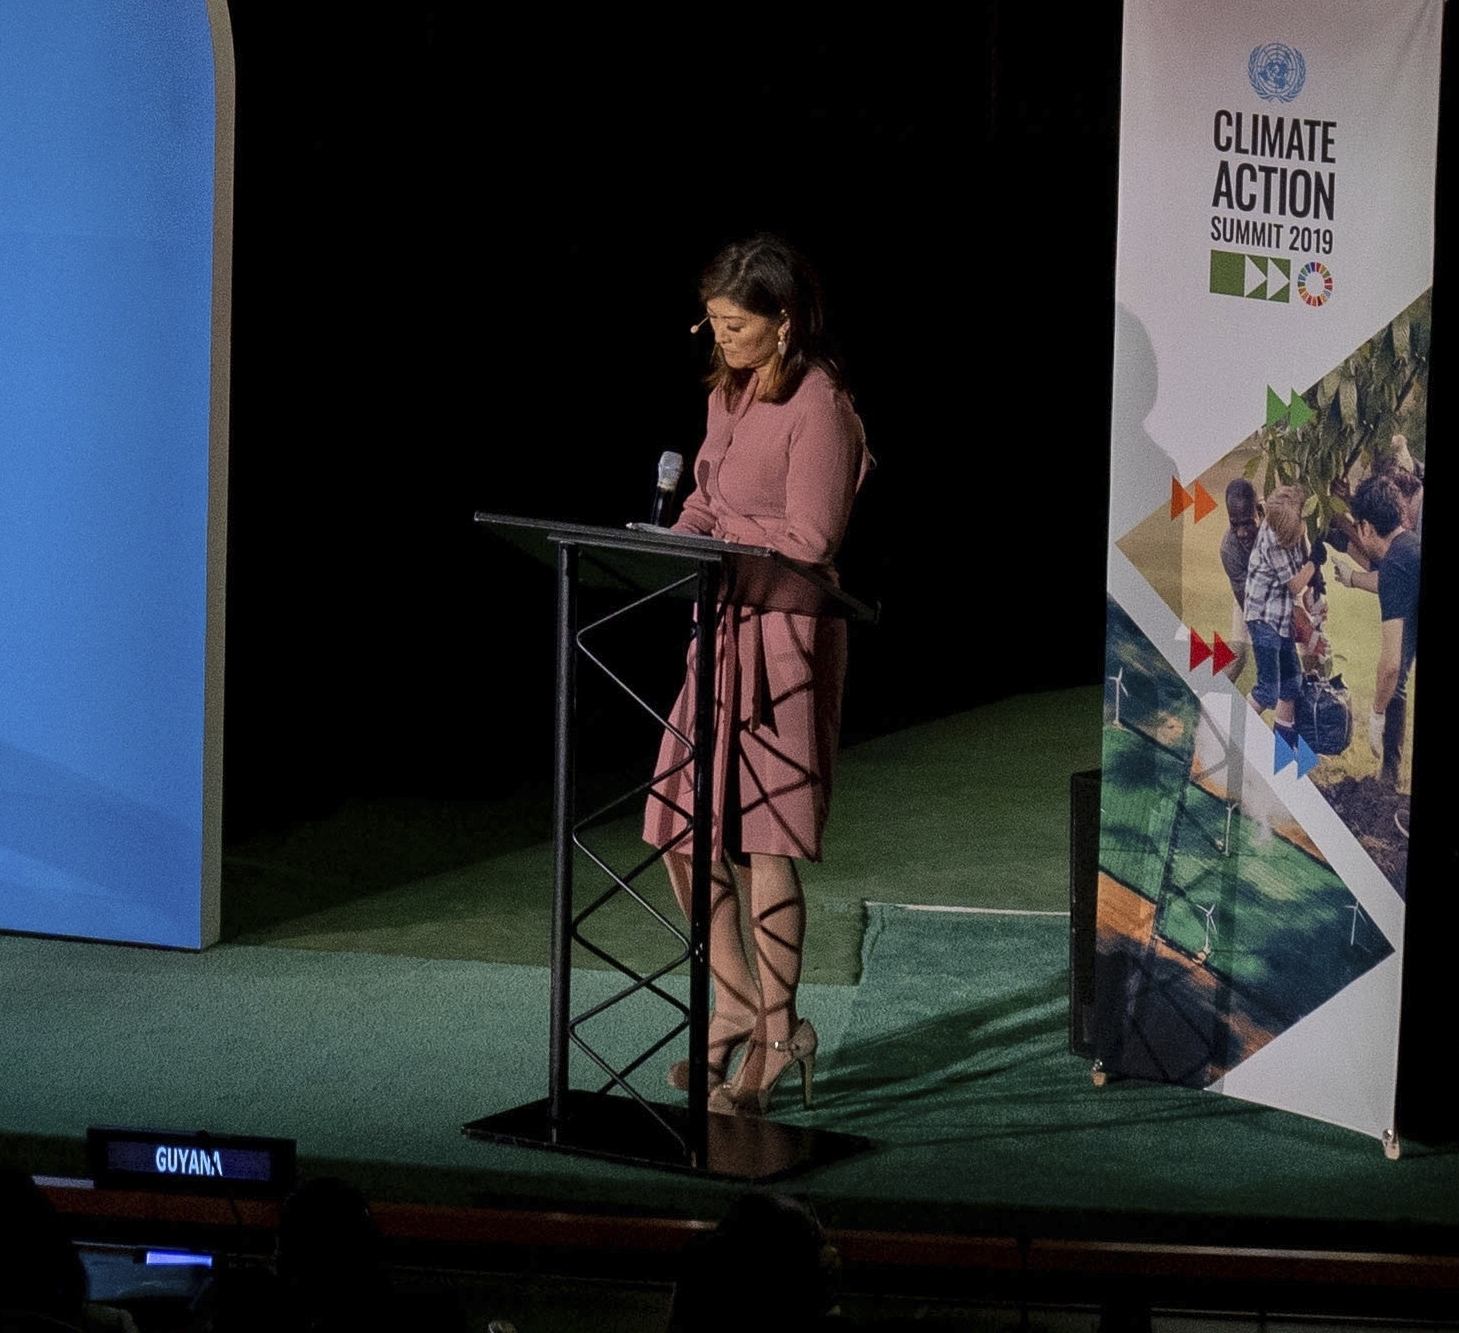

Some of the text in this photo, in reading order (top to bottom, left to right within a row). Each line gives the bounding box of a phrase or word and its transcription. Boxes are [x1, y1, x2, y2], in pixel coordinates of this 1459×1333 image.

[1213, 109, 1337, 164] CLIMATE
[1212, 160, 1335, 221] ACTION
[1210, 216, 1334, 255] SUMMIT 2019
